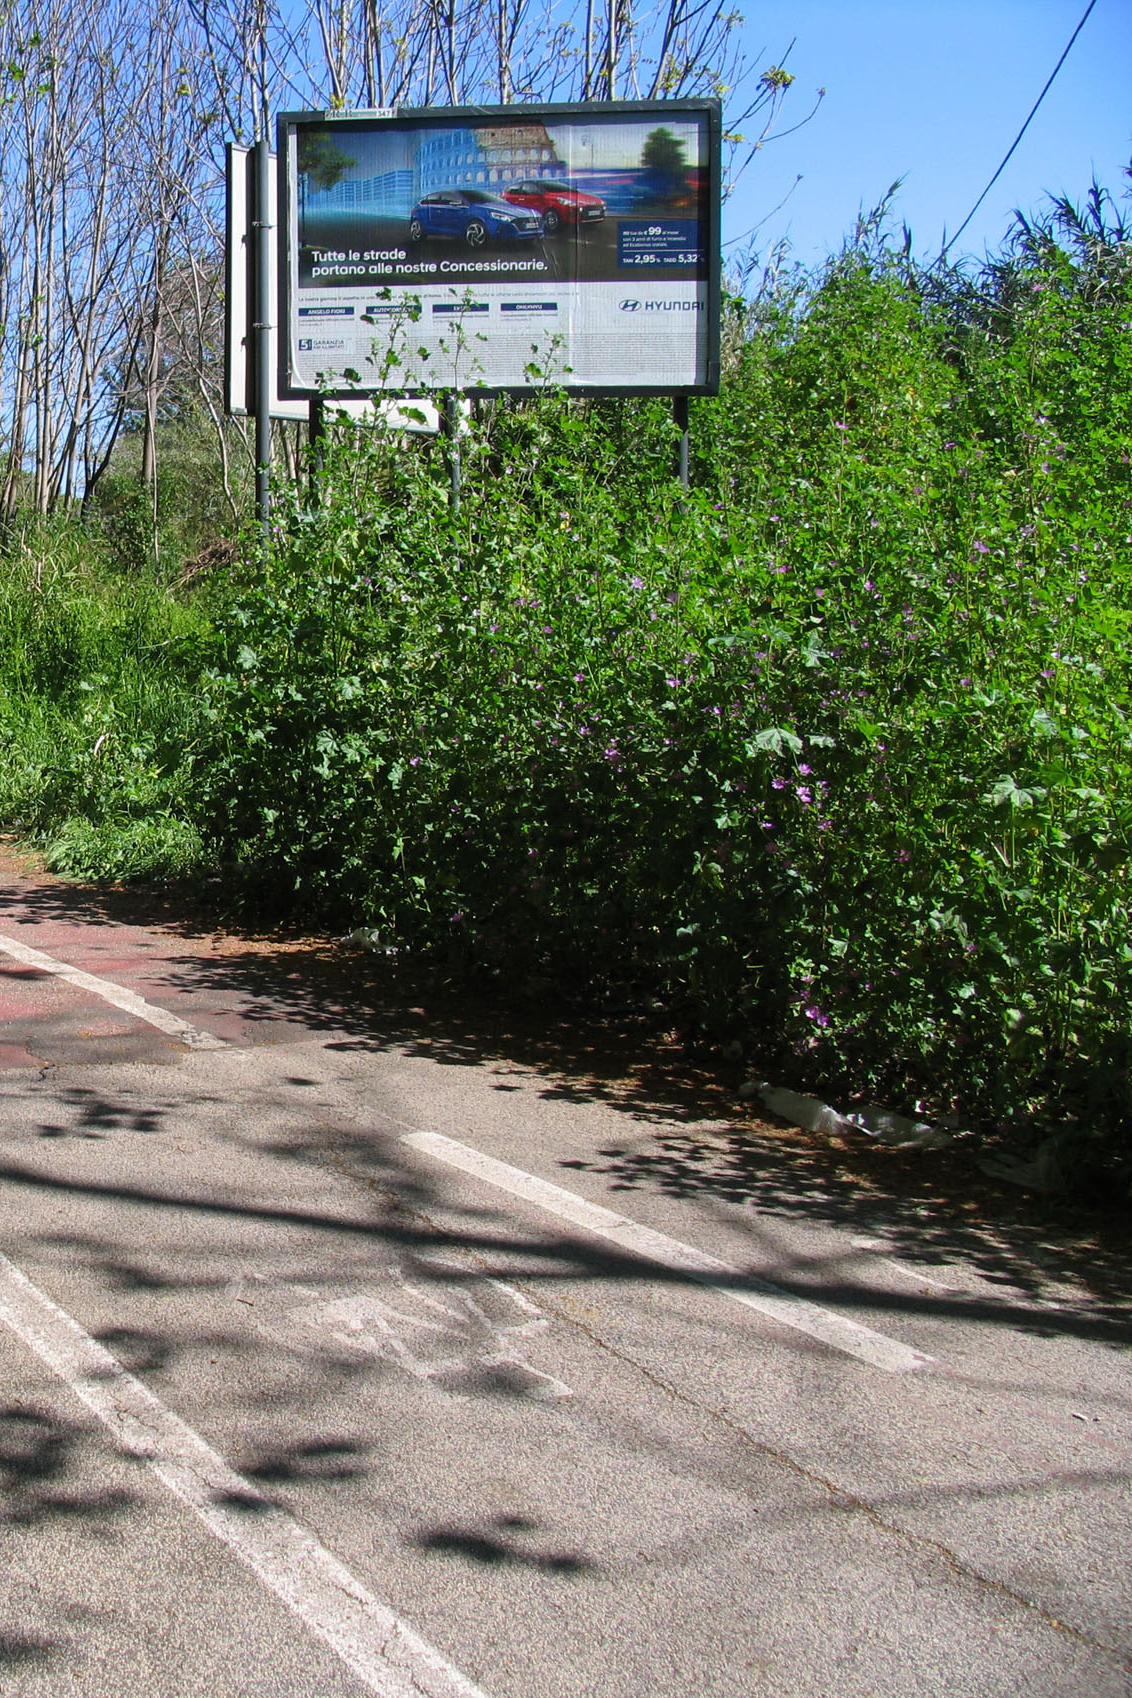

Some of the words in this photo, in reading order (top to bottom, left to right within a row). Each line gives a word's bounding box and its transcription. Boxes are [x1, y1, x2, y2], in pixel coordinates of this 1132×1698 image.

[648, 226, 662, 235] 99
[312, 251, 346, 262] Tutte
[349, 250, 360, 261] le
[363, 248, 406, 260] strade
[312, 264, 366, 278] portano
[368, 262, 393, 274] alle
[395, 262, 437, 273] nostre
[440, 259, 548, 272] Concessionarie.
[645, 301, 704, 311] HYUNDAI
